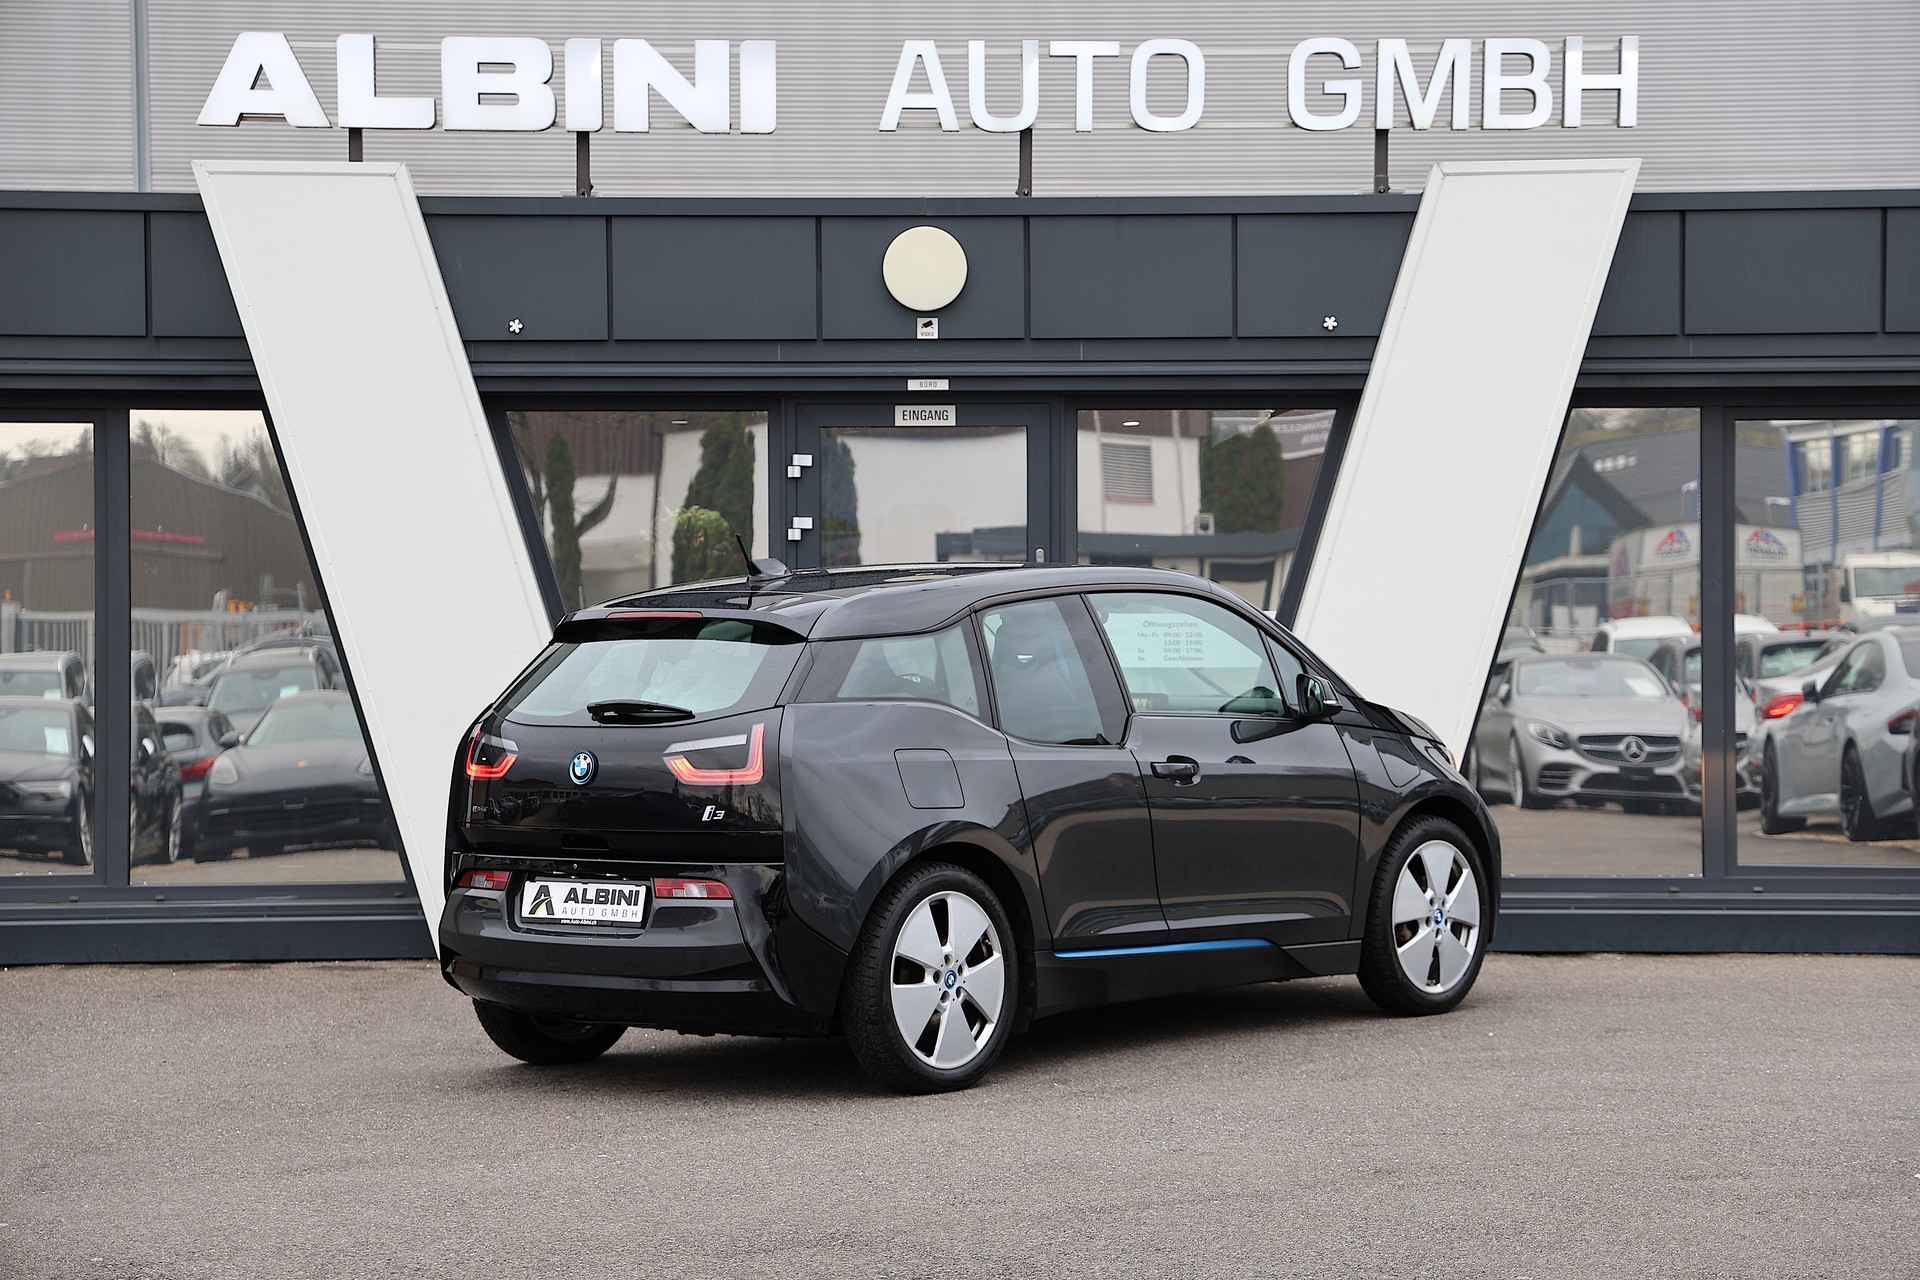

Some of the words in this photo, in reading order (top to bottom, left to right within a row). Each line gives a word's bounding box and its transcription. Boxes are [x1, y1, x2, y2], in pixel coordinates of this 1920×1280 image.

[195, 32, 777, 134] ALBINI
[879, 38, 1206, 133] AUTO
[1287, 35, 1640, 132] GMBH
[902, 410, 949, 421] EINGANG
[702, 805, 725, 821] i3
[563, 887, 640, 906] ALBINI
[561, 906, 595, 917] AUTO
[601, 908, 638, 919] GMBH
